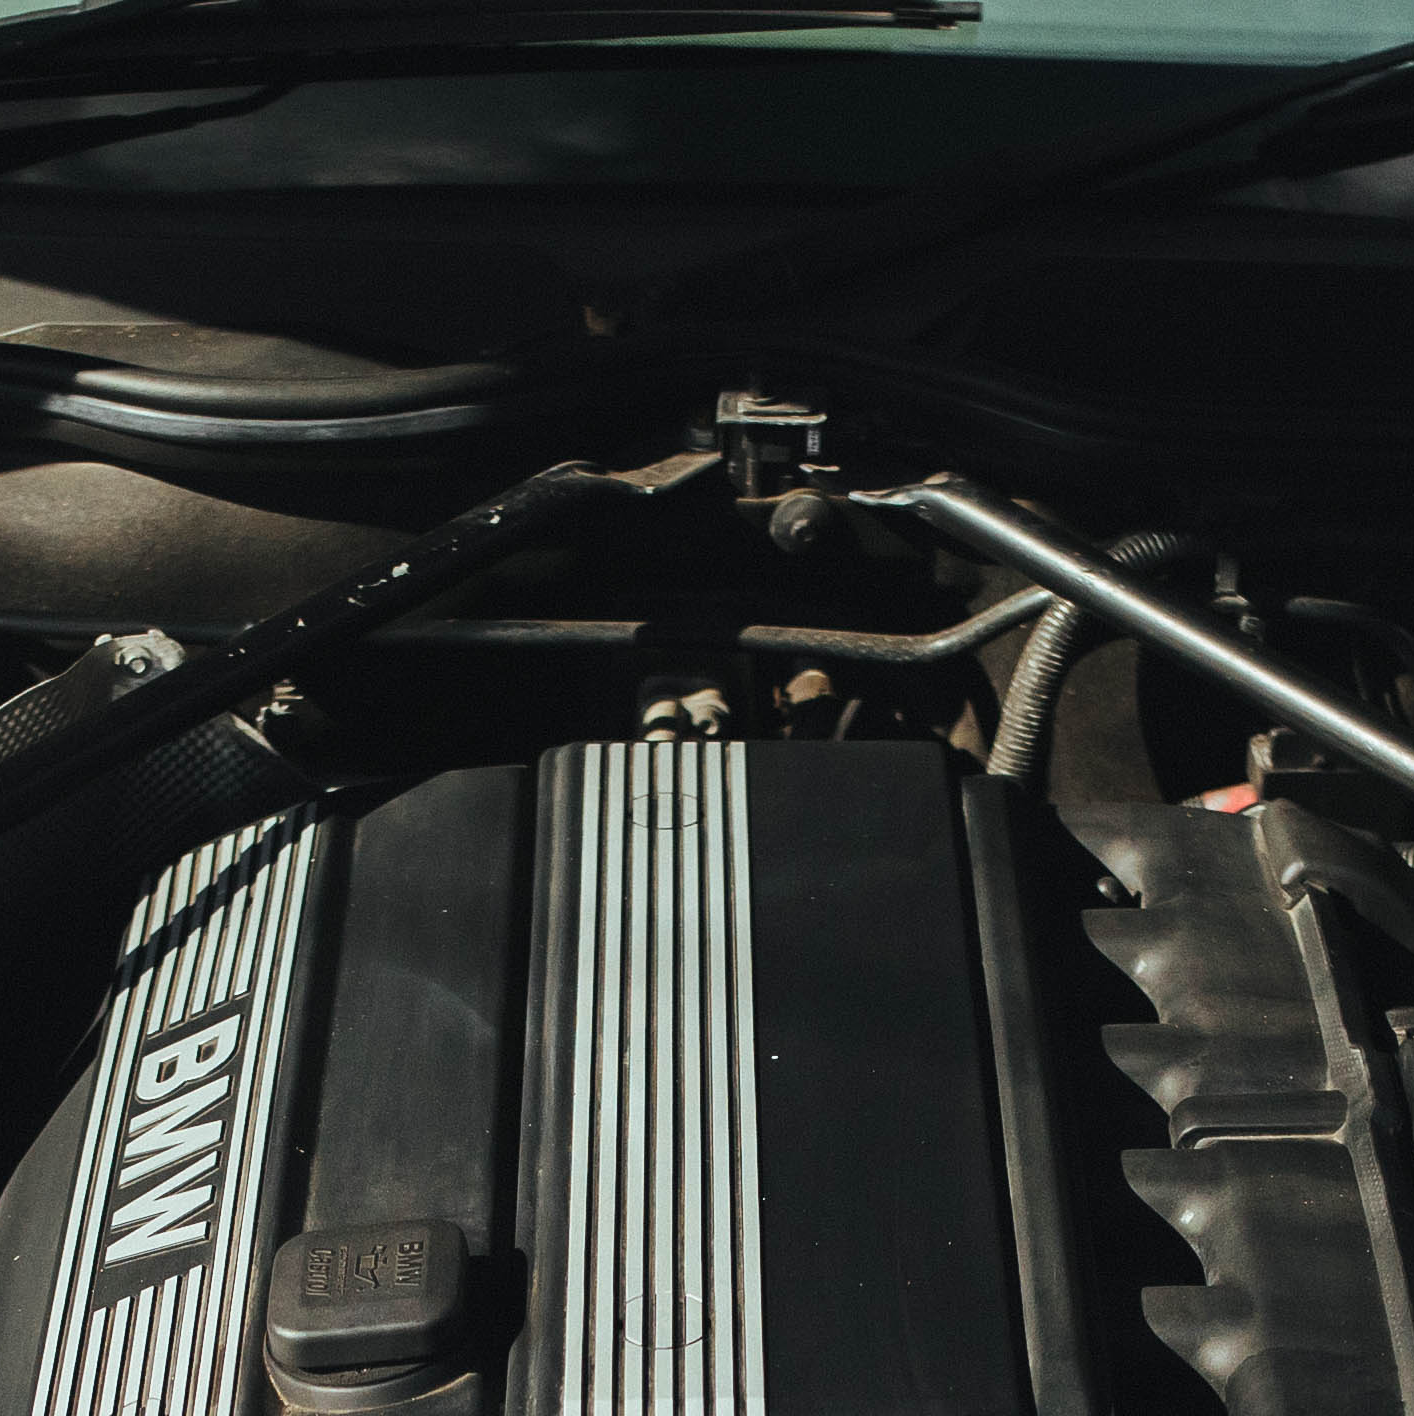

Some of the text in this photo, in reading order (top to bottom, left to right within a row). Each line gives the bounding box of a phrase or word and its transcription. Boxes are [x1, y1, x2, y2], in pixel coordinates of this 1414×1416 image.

[103, 1014, 245, 1267] BMW
[305, 1246, 333, 1298] Castrol
[395, 1240, 427, 1287] BMW
